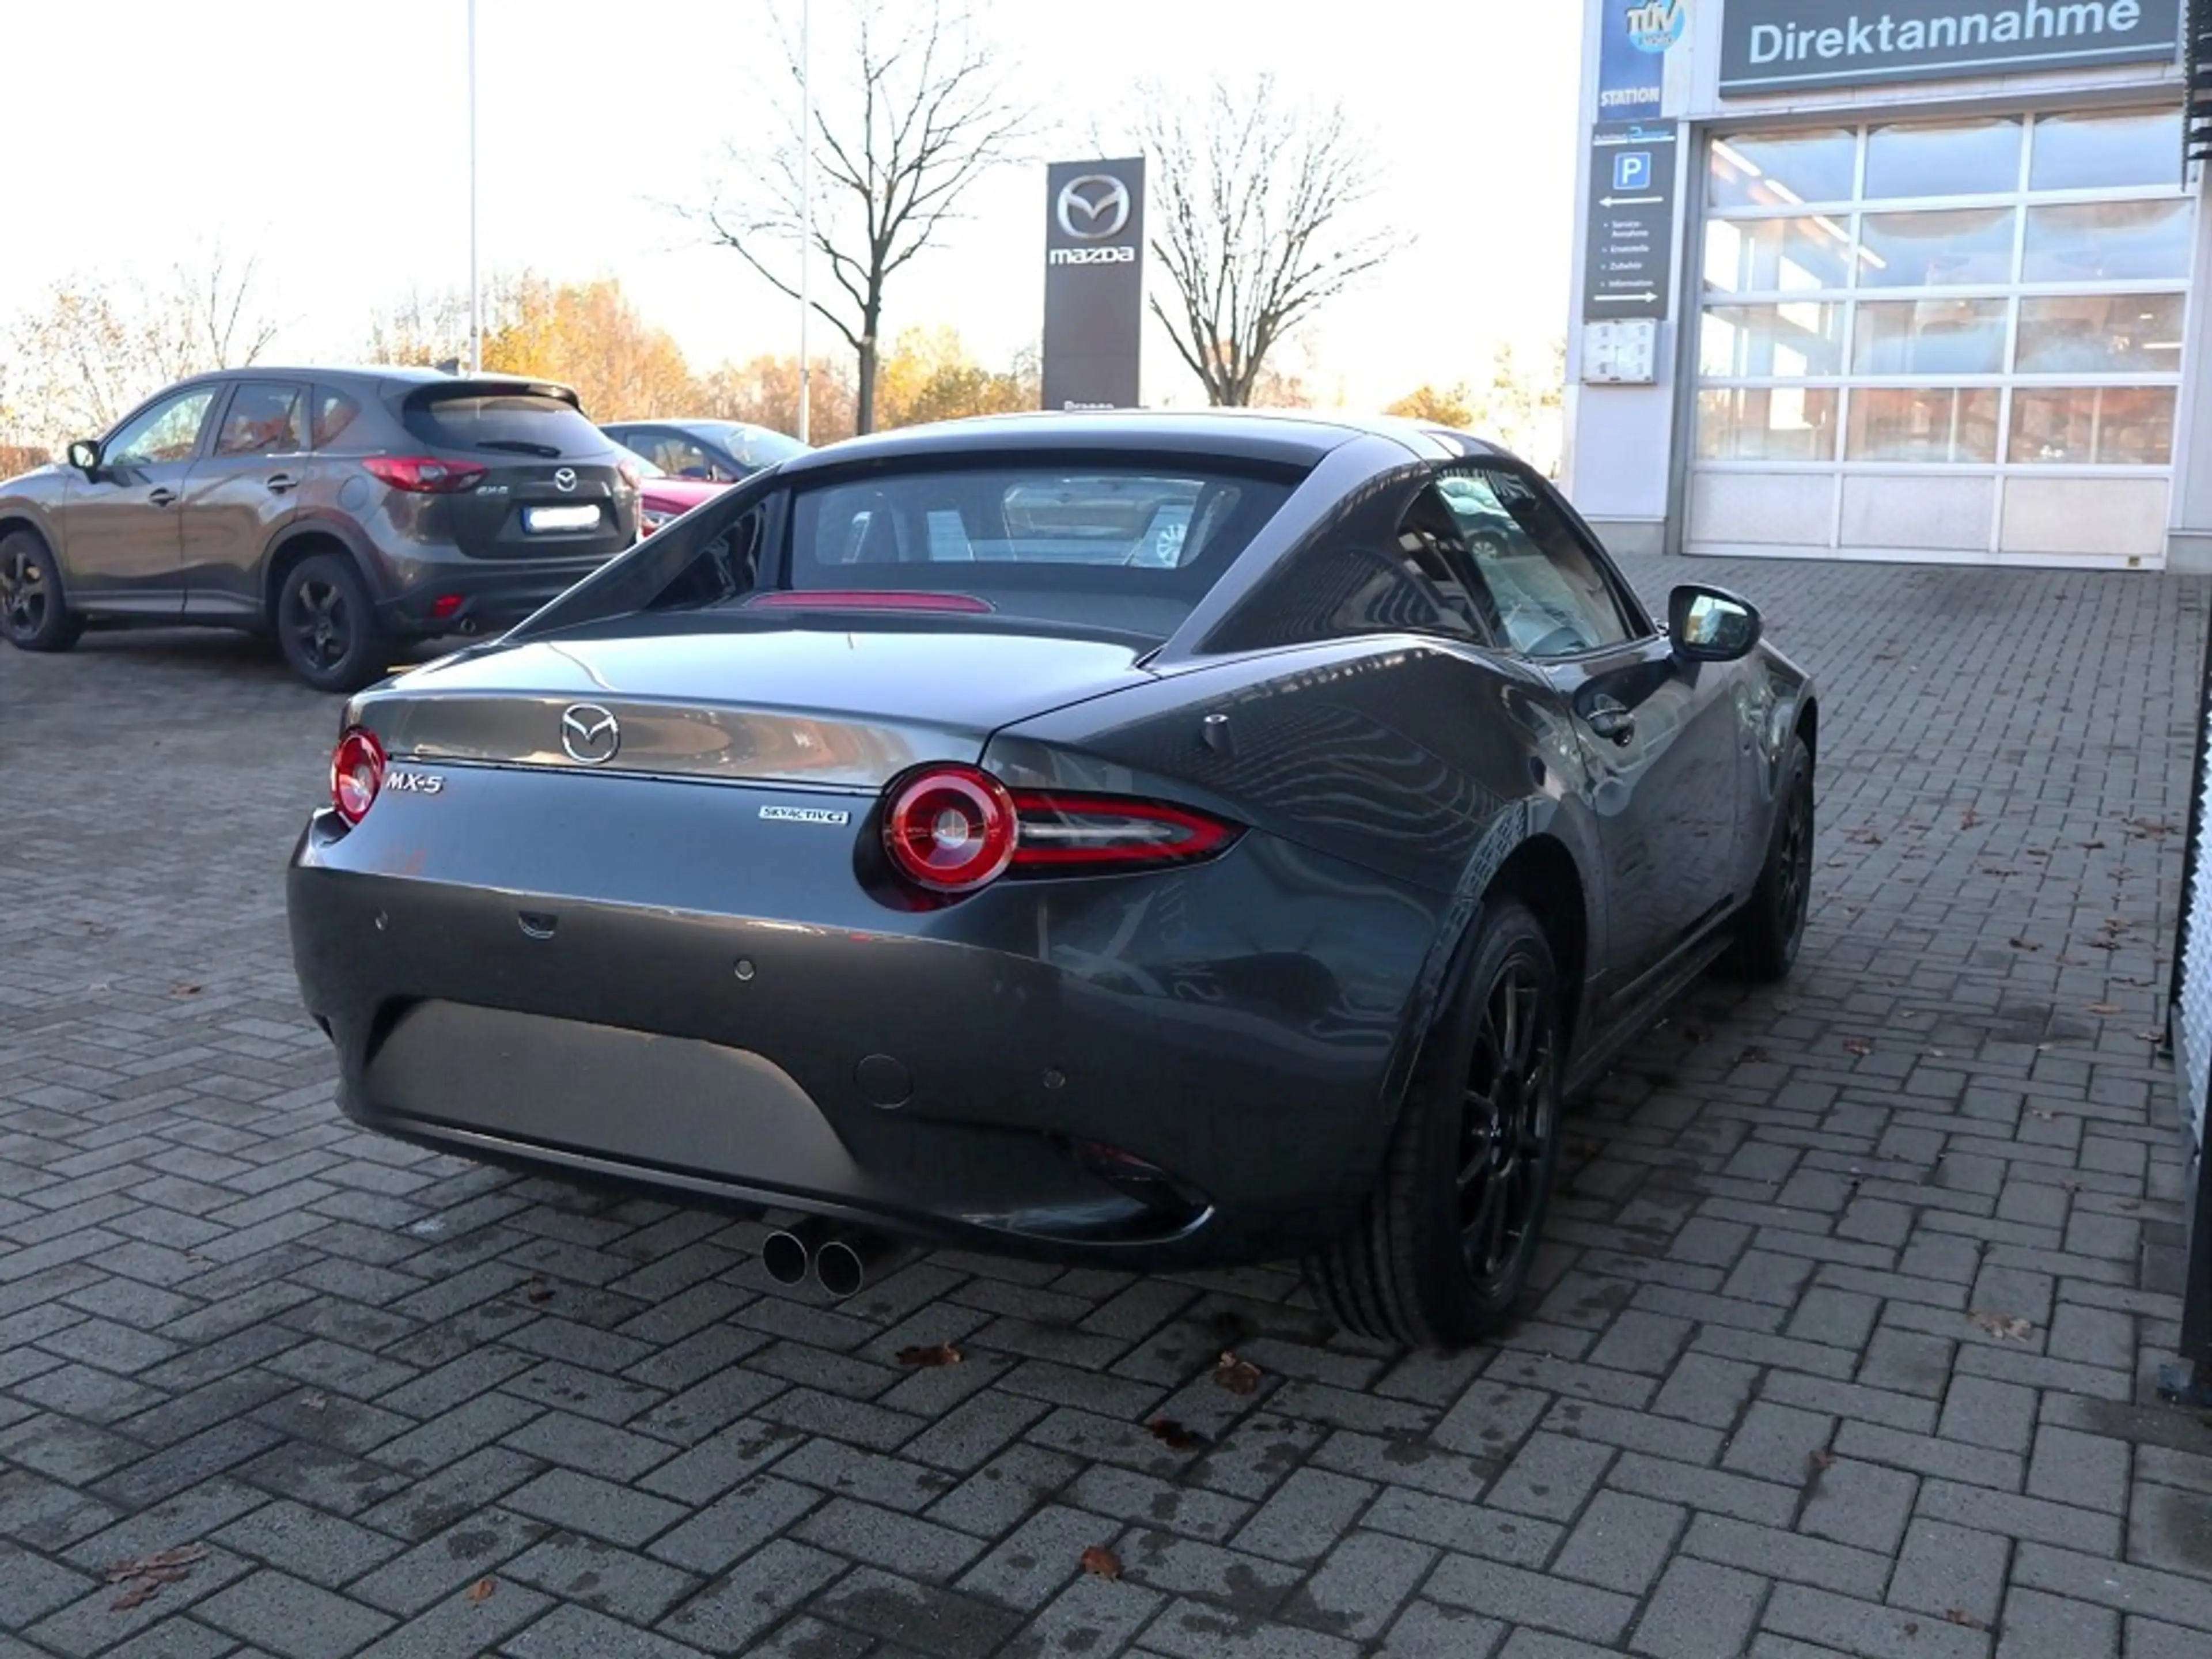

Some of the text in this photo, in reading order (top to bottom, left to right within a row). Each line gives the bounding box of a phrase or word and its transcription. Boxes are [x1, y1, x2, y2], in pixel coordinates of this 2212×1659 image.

[1749, 0, 2141, 64] Direktannahme
[1601, 88, 1660, 107] STATION
[1622, 157, 1642, 184] P
[1050, 247, 1134, 264] mazda
[387, 772, 443, 793] MX-5
